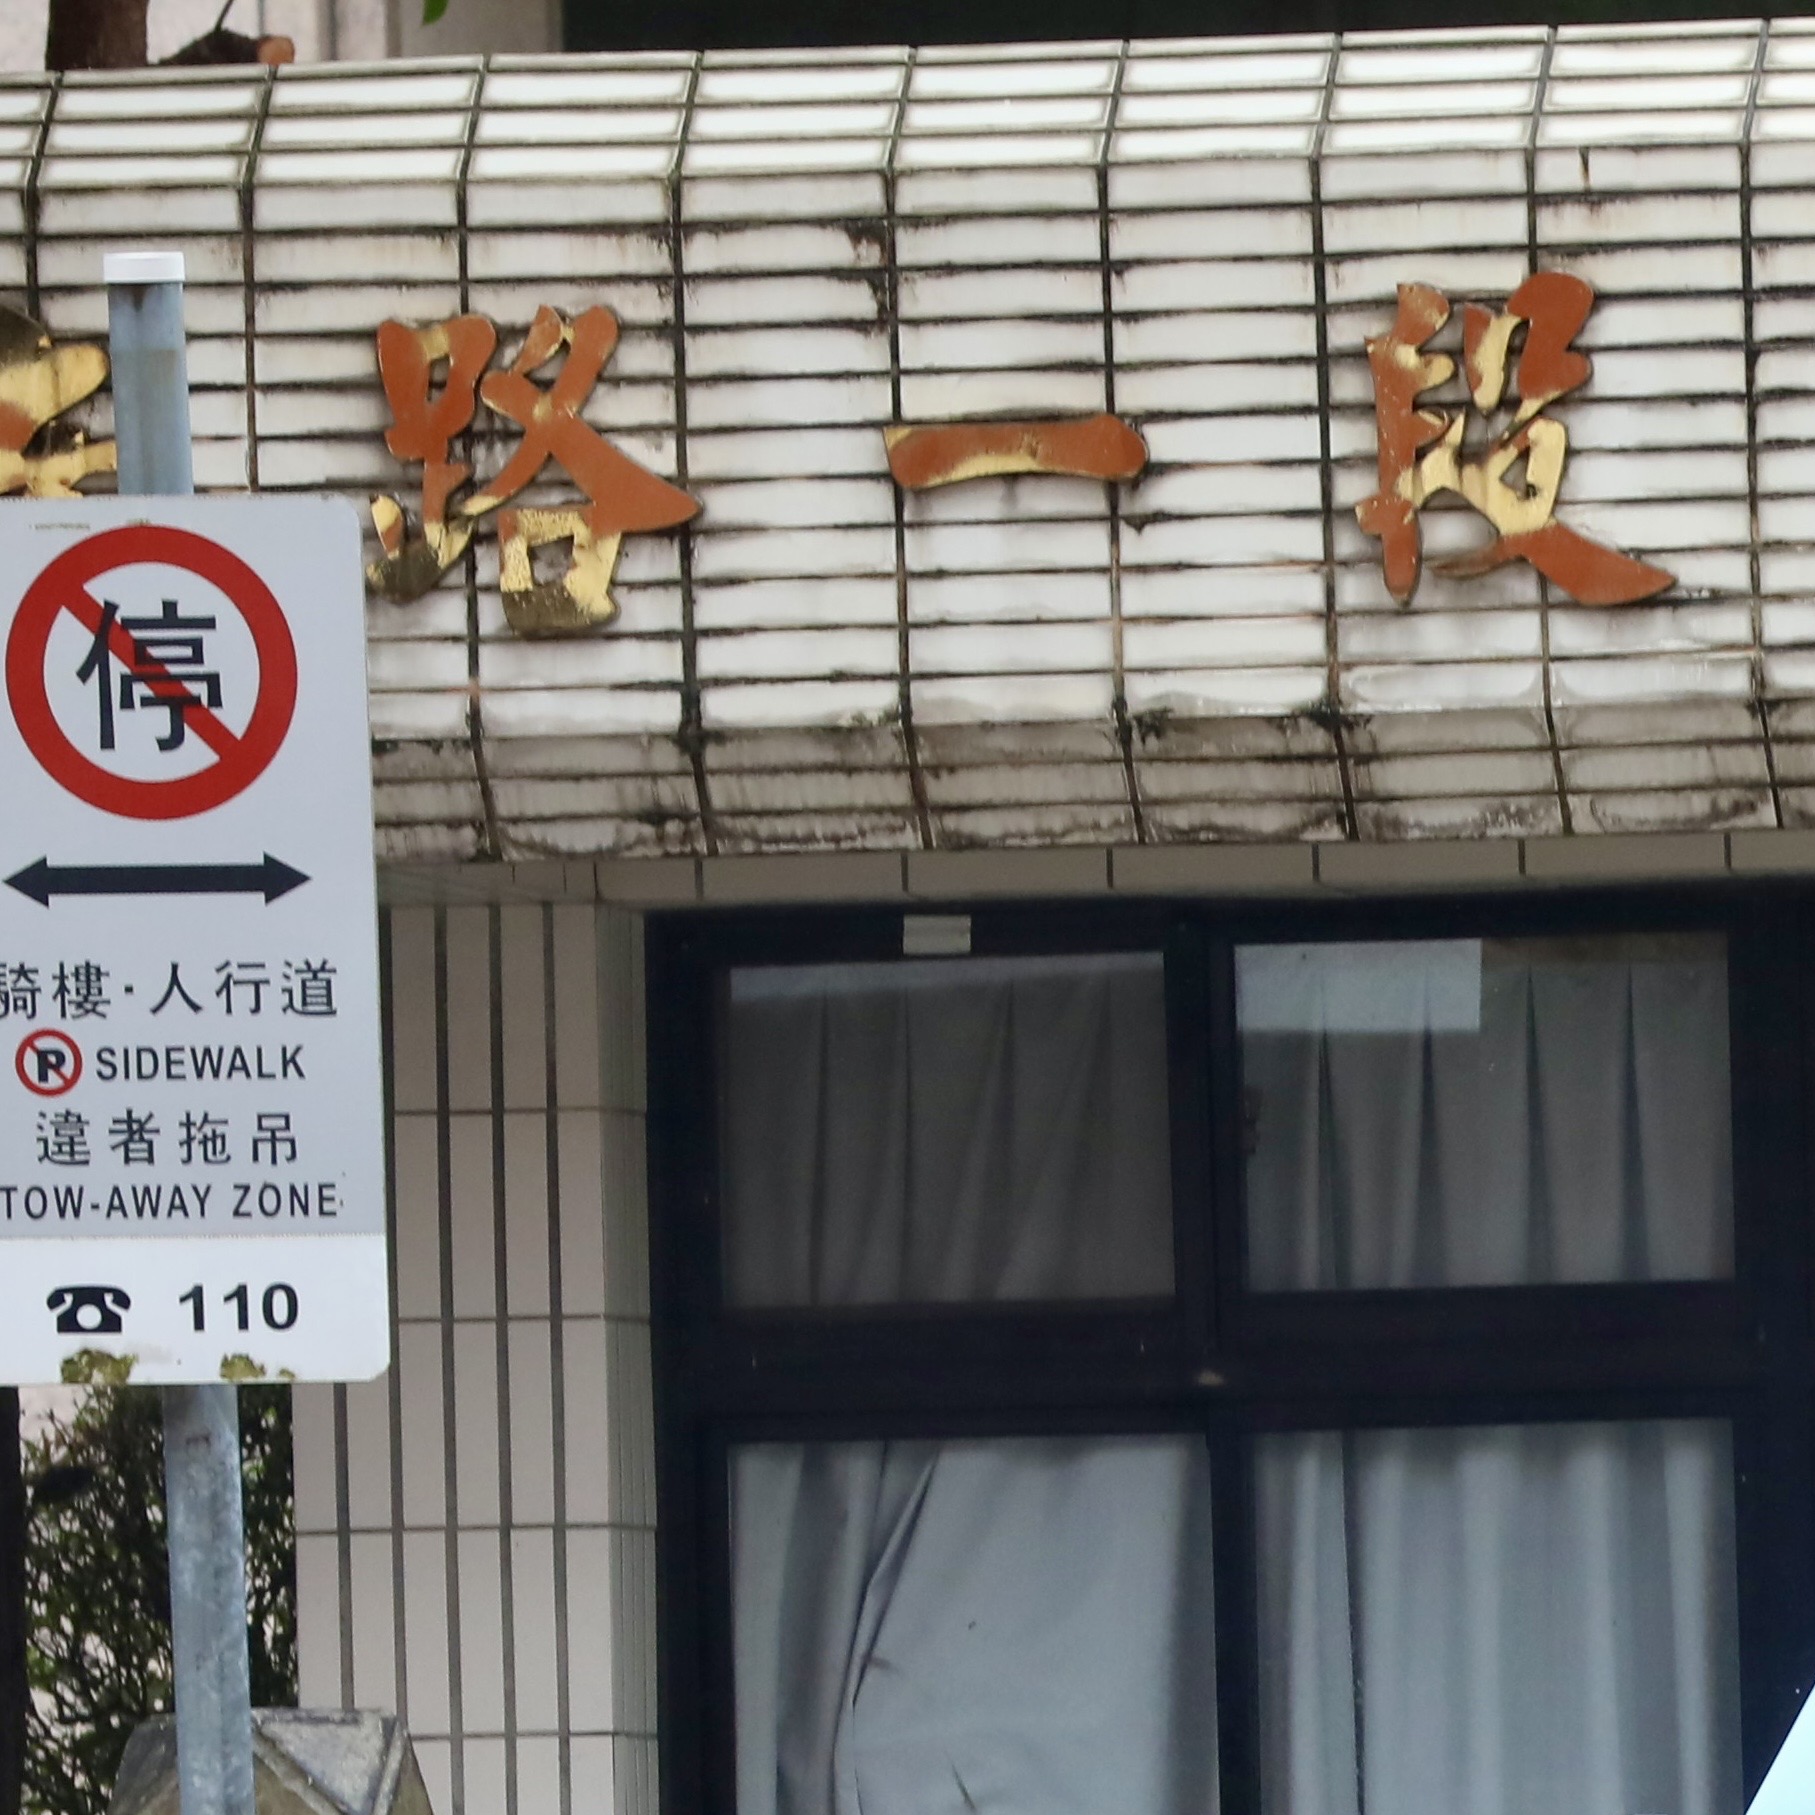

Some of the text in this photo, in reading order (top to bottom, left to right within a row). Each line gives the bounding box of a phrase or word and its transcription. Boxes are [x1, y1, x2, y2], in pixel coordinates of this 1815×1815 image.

[76, 599, 224, 753] 停
[96, 1045, 306, 1081] SIDEWALK
[36, 1108, 300, 1167] 違者拖吊
[0, 1182, 338, 1220] TOW-AWAY ZONE
[178, 1282, 300, 1332] 110
